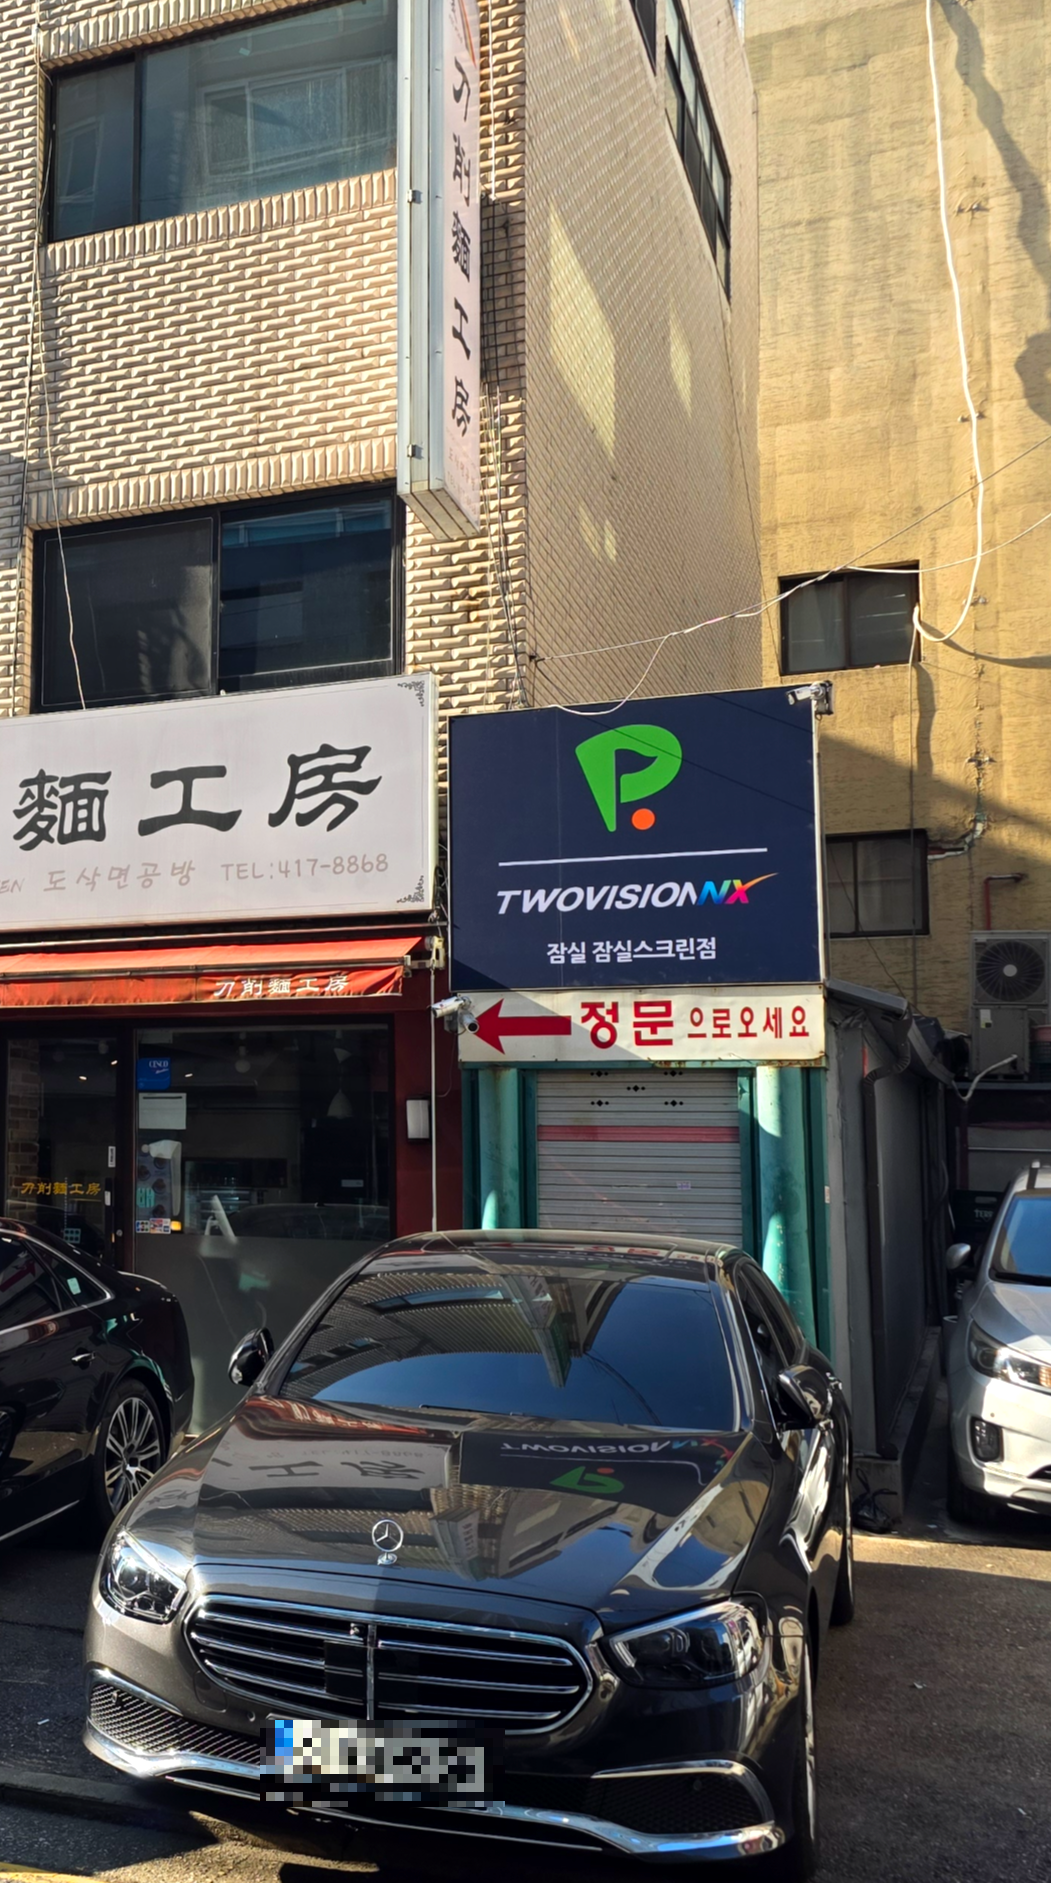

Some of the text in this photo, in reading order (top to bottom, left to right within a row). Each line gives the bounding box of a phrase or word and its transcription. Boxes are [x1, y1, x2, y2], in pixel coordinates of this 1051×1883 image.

[43, 860, 196, 892] 도삭면공방
[221, 853, 389, 882] TEL:417-8868
[546, 937, 717, 965] 잠실 잠실스크린점
[213, 975, 350, 997] 刀削麵工房
[580, 1000, 810, 1049] 정문 으로오세요
[21, 1182, 102, 1196] 刀削麵工房
